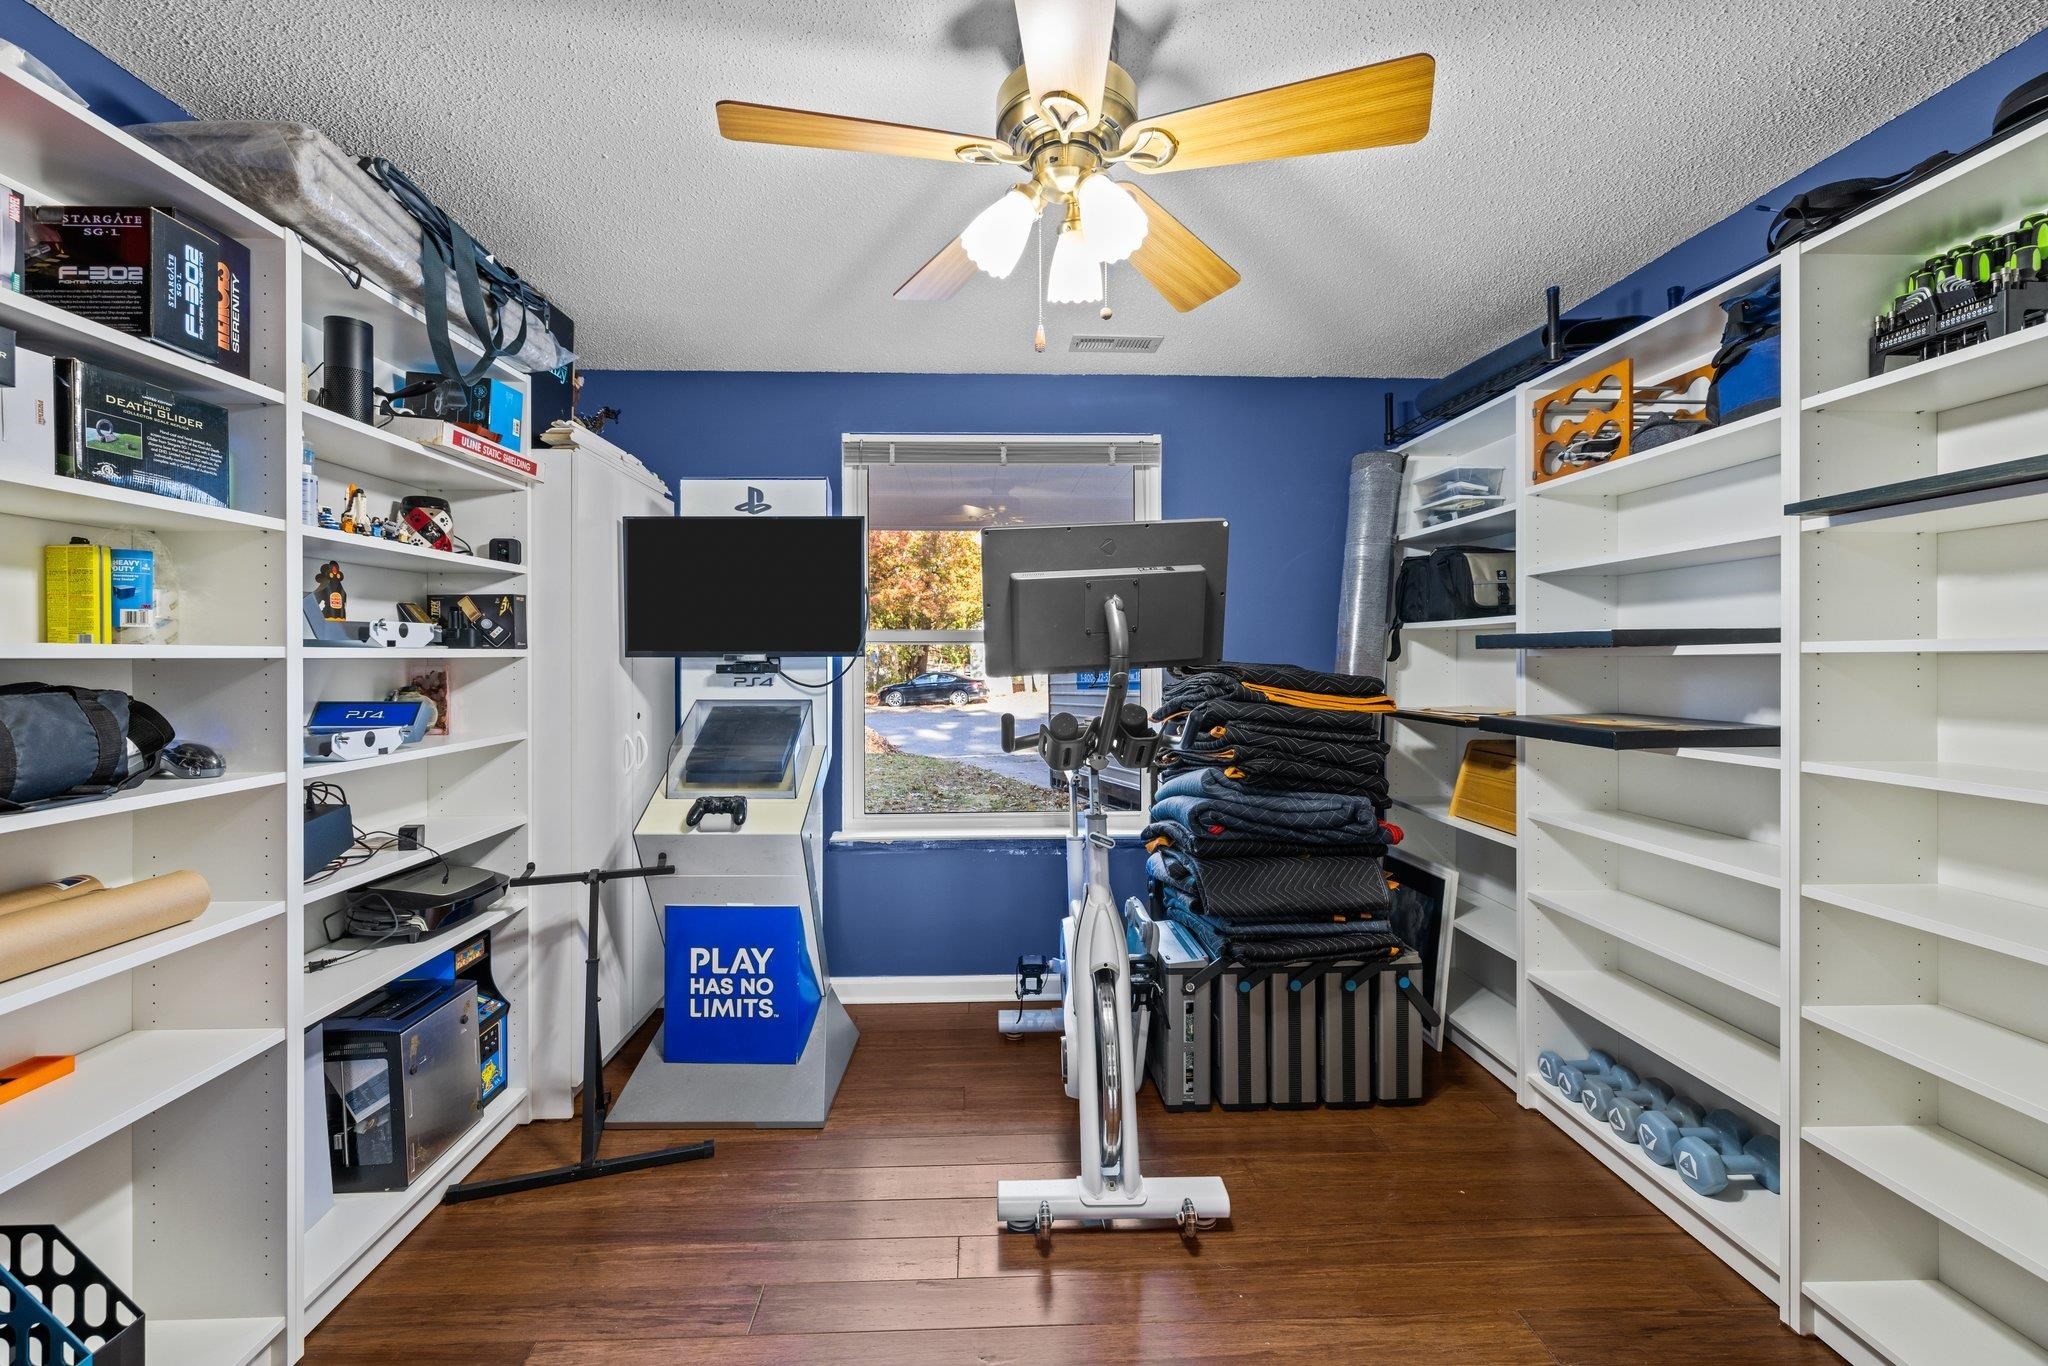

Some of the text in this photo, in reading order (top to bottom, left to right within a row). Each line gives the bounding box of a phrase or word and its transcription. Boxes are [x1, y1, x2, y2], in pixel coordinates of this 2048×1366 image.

[62, 212, 142, 224] STARGATE
[58, 266, 143, 280] F-302
[166, 253, 175, 309] STARGATE
[185, 244, 199, 339] F-302
[232, 272, 240, 354] SERENITY
[106, 394, 203, 429] DEATH GLIDER
[462, 436, 531, 471] ULINE STATIC SHIELDING
[734, 677, 773, 686] PS4
[690, 948, 774, 974] PLAY
[690, 978, 774, 995] HAS NO
